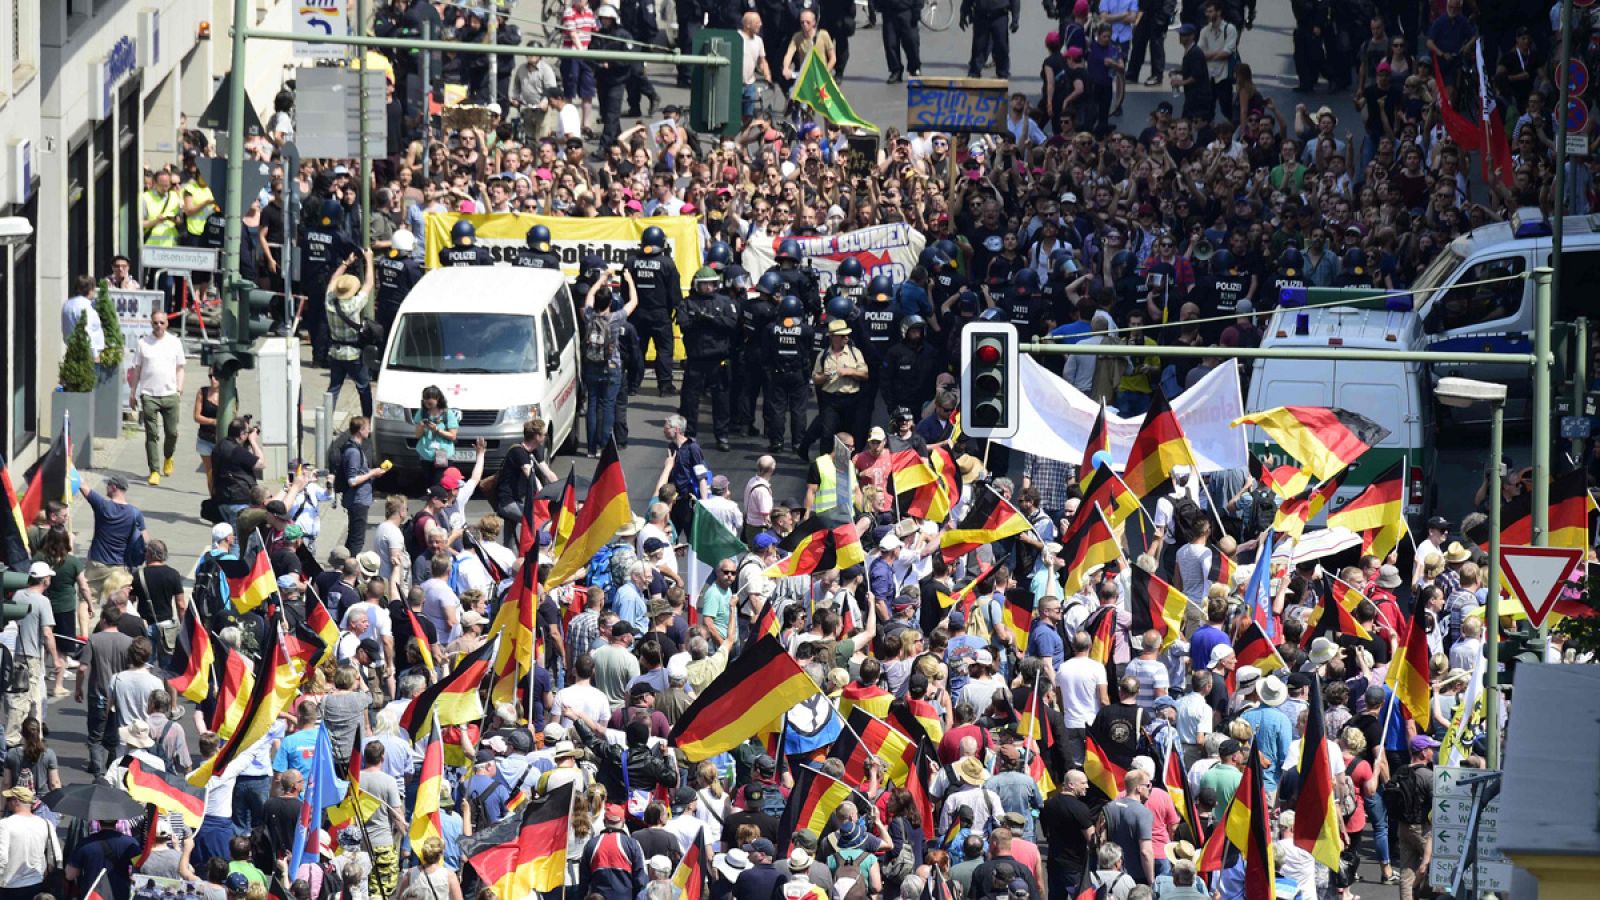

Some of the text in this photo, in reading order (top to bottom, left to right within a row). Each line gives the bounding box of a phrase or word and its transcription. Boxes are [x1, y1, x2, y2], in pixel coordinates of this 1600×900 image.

[307, 231, 333, 244] POLIZEI
[837, 222, 910, 254] BLUMEN
[448, 251, 477, 261] POLIZEI
[517, 256, 545, 268] POLIZEI
[634, 259, 661, 270] POLIZEI
[1215, 281, 1242, 292] POLIZEI
[864, 311, 893, 321] POLIZEI
[774, 325, 802, 336] POLIZEI
